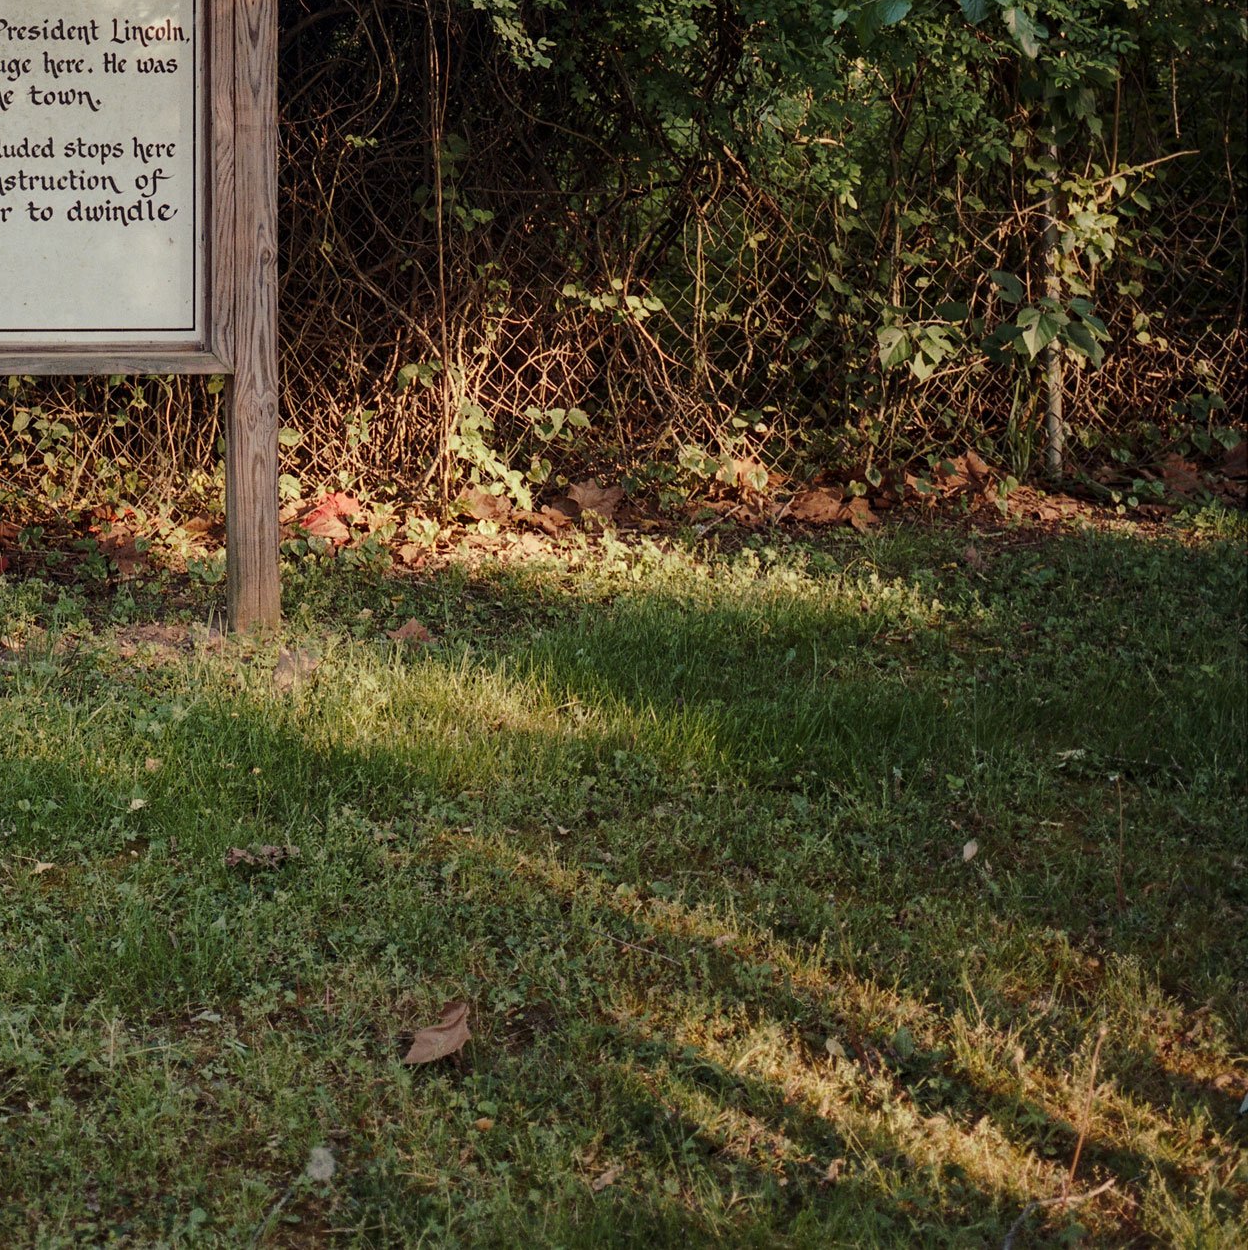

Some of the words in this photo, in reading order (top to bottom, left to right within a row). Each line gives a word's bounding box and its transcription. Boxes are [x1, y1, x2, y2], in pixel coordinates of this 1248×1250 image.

[110, 17, 191, 48] Lincoln,
[42, 50, 94, 80] here.
[102, 51, 128, 74] He
[136, 57, 178, 74] was
[26, 84, 102, 113] town.
[63, 136, 125, 166] stops
[131, 136, 176, 165] here
[134, 167, 171, 199] of
[25, 200, 54, 222] to
[66, 199, 179, 227] dwindle
